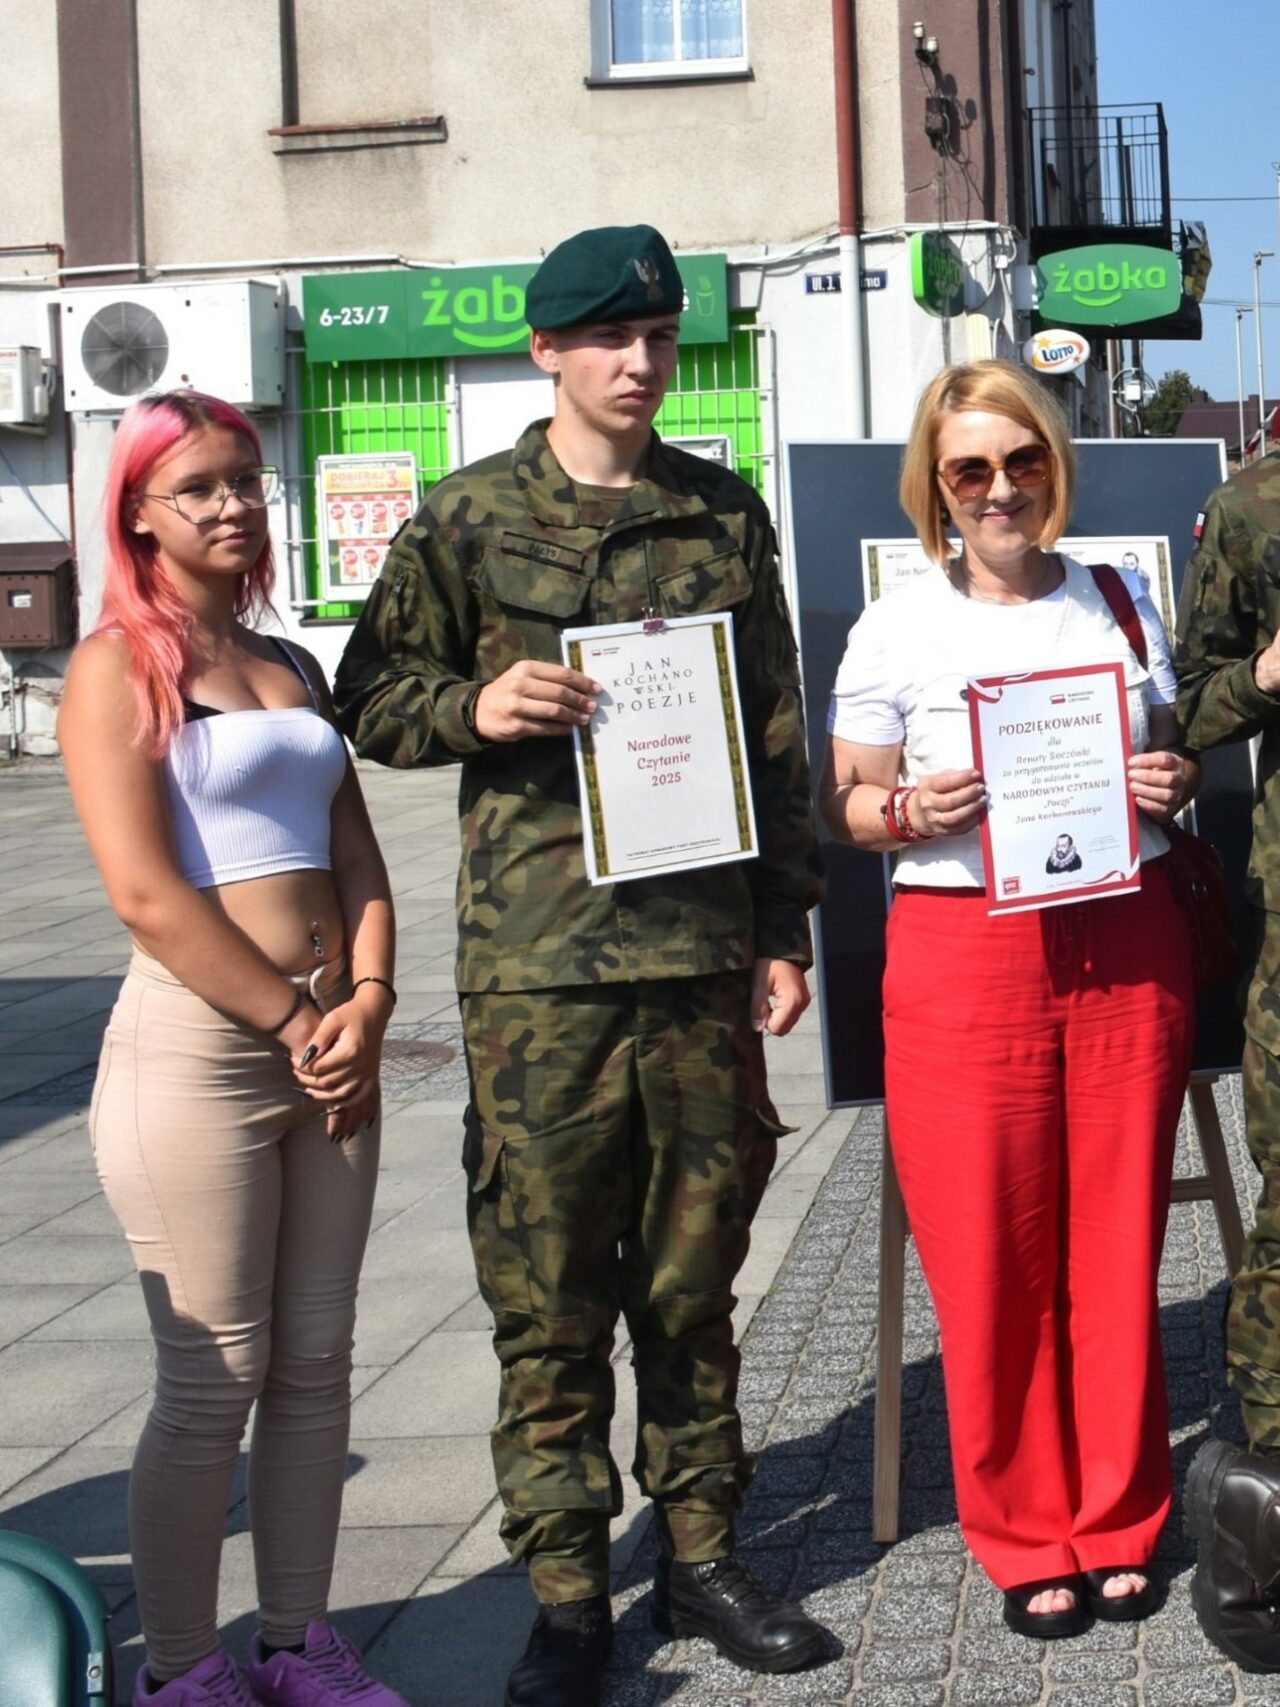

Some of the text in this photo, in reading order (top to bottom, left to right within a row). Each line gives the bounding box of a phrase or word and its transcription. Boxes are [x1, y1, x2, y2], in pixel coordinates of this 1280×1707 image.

[1053, 261, 1166, 293] żabka
[421, 275, 526, 326] żab
[319, 305, 389, 327] 6-23/7
[1042, 344, 1074, 362] LOTTO
[629, 657, 671, 677] JAN
[613, 669, 693, 688] KOCHANO
[617, 691, 697, 714] POEZJE
[998, 713, 1103, 737] PODZIĘKOWANIE
[627, 733, 692, 753] Narodowe
[1047, 736, 1062, 747] dla
[637, 751, 691, 771] Czytanie
[1016, 754, 1047, 765] Renaty
[651, 771, 682, 787] 2025
[1002, 779, 1110, 801] NARODOWYM CZYTANIU
[1015, 805, 1102, 825] Jana Kochanowskiego
